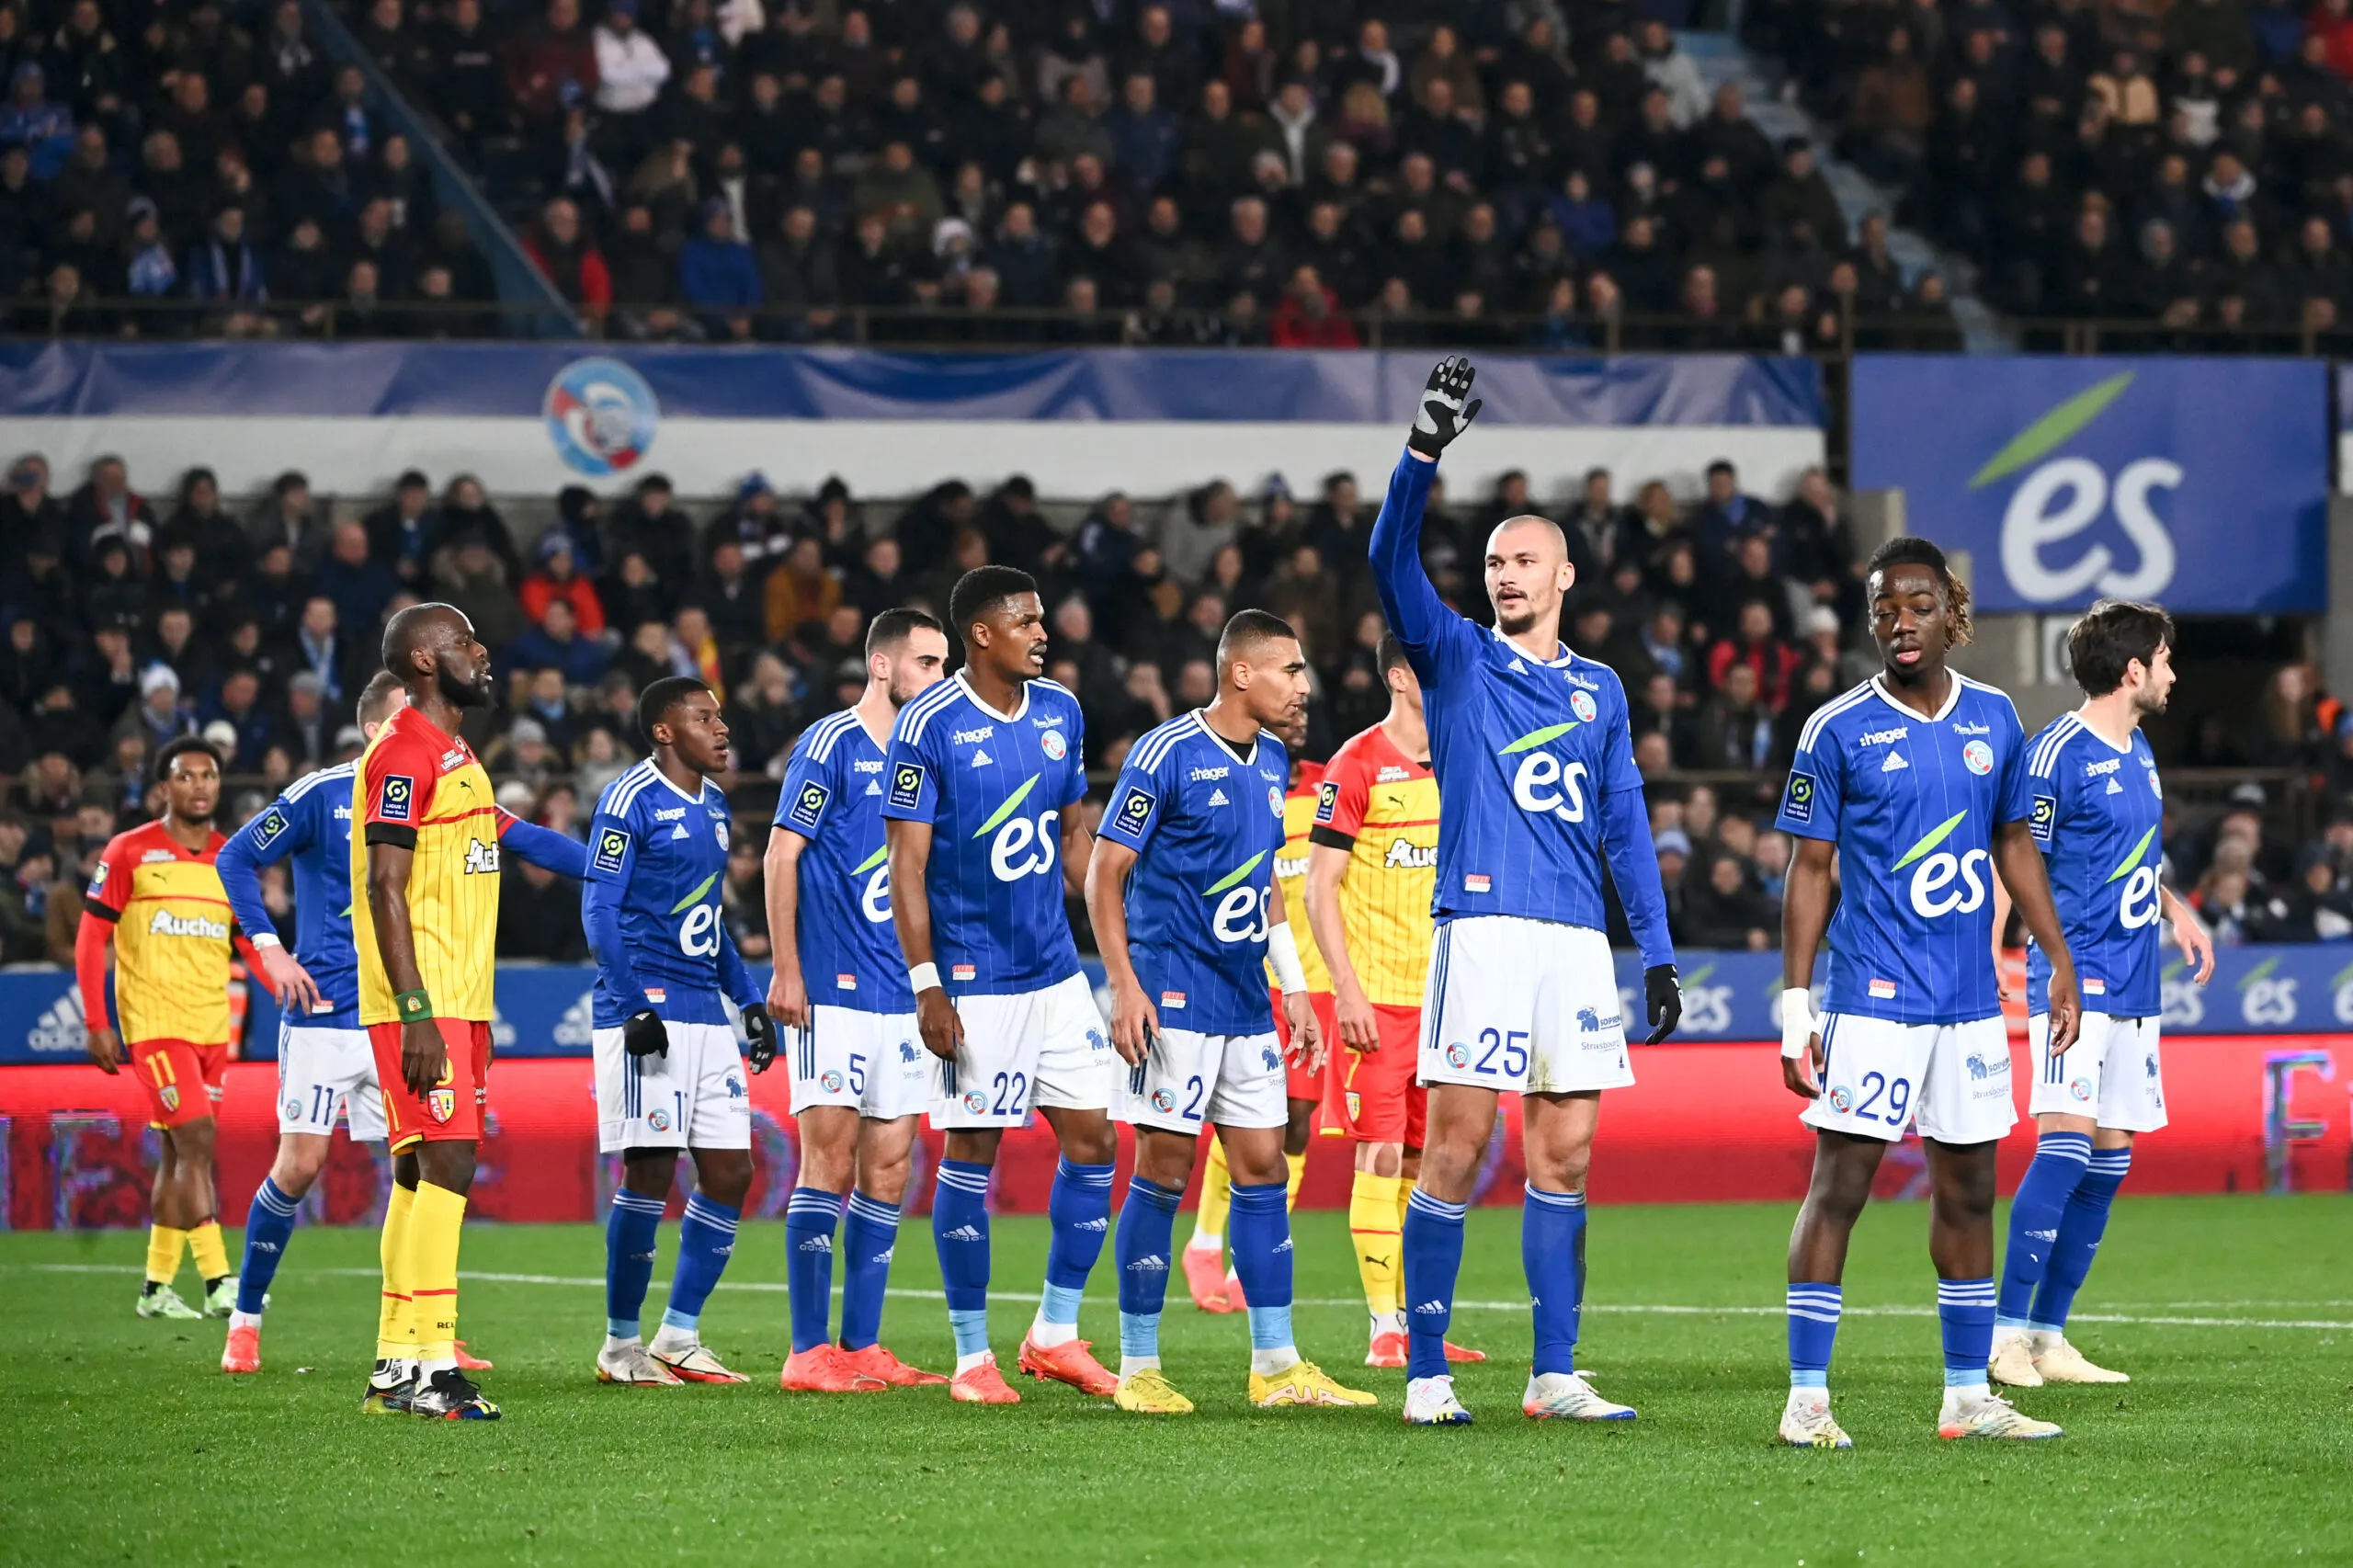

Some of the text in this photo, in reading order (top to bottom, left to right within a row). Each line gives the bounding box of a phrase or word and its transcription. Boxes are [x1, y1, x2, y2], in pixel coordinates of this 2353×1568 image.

[145, 1049, 177, 1089] 11
[848, 1052, 867, 1096] 5
[1473, 1027, 1530, 1078] 25
[311, 1084, 335, 1126] 11
[992, 1071, 1028, 1117] 22
[1180, 1074, 1205, 1121] 2
[1854, 1070, 1911, 1127] 29
[942, 1232, 986, 1242] adidas
[1126, 1263, 1169, 1272] adidas
